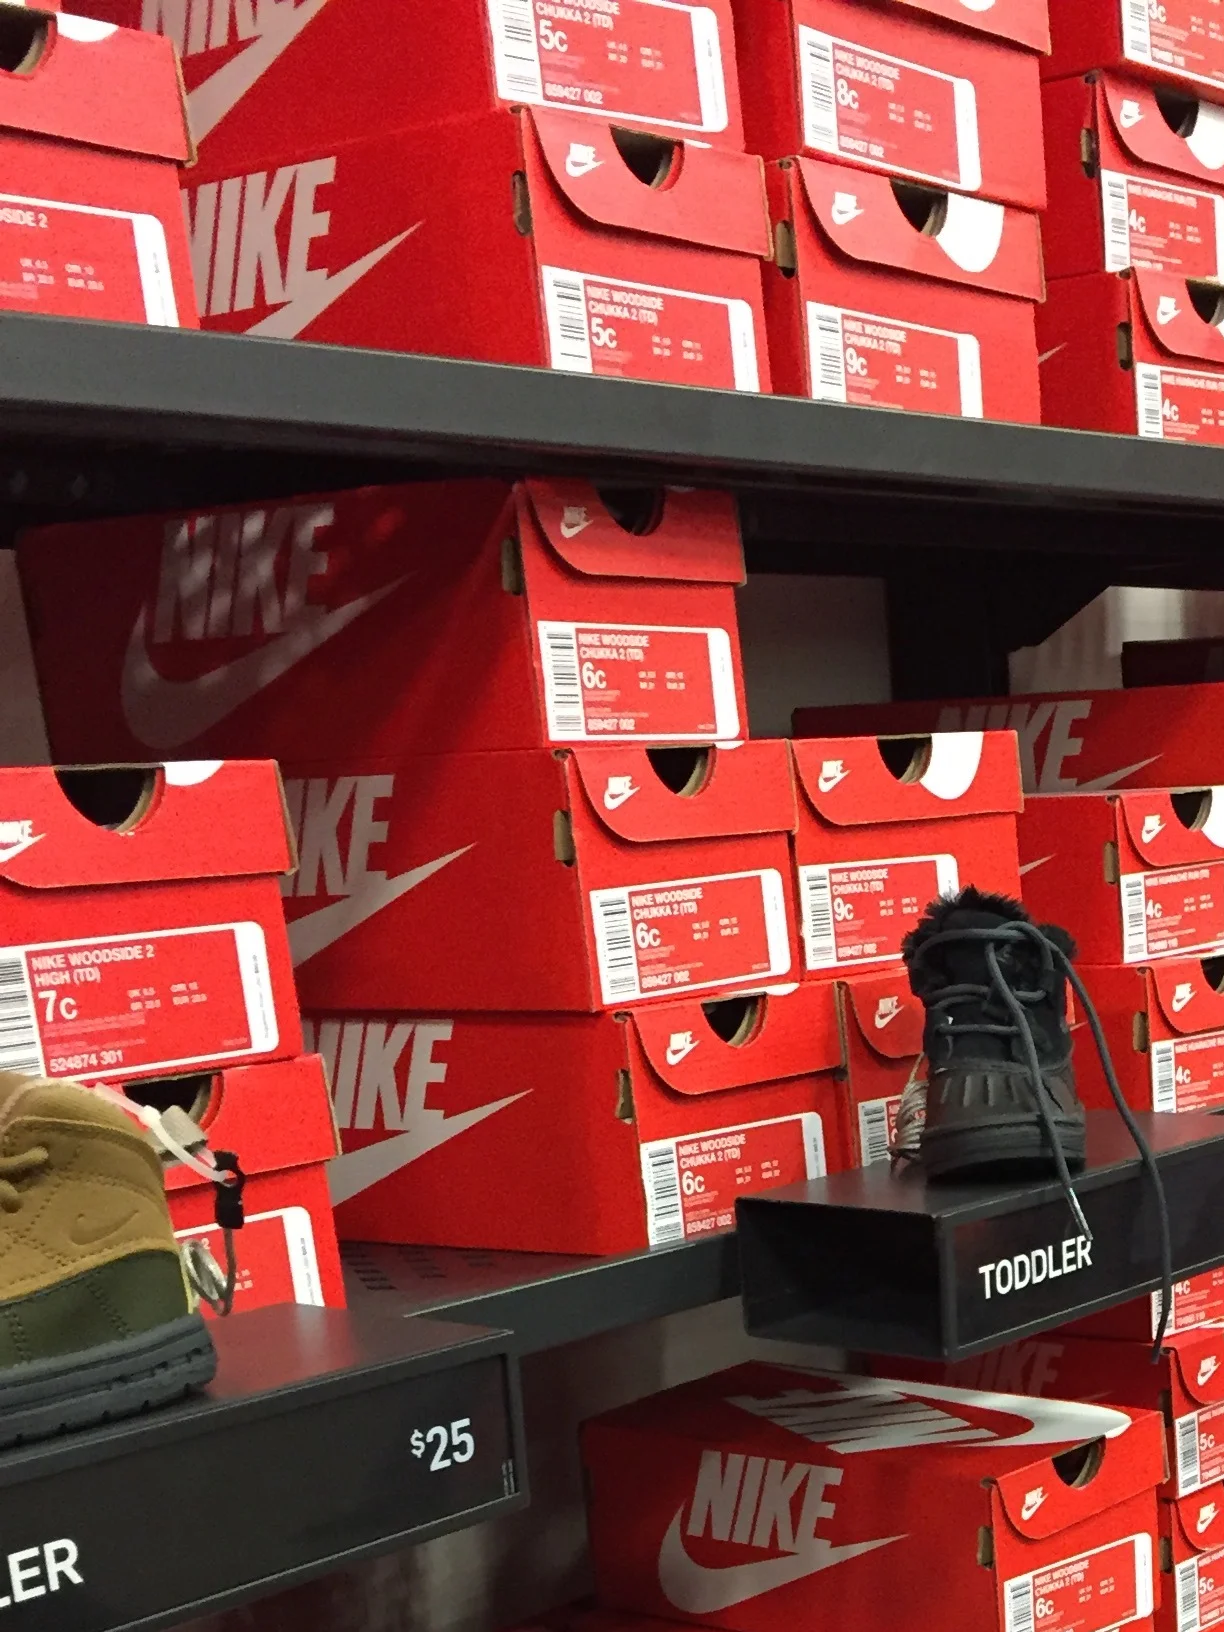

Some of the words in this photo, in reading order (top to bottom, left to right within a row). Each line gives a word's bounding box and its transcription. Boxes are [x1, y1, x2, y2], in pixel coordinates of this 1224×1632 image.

[540, 19, 568, 53] 5c
[837, 78, 859, 110] 8c
[591, 317, 618, 349] 5c
[846, 347, 868, 377] 9c
[153, 503, 337, 645] NIKE
[582, 661, 607, 690] 6c
[833, 897, 854, 922] 9c
[1146, 899, 1162, 919] 4c
[636, 922, 661, 949] 6c
[32, 952, 66, 971] NIKE
[69, 947, 143, 967] WOODSIDE
[145, 944, 155, 958] 2
[34, 970, 71, 988] HIGH
[73, 966, 101, 987] (TD)
[38, 990, 78, 1023] 7c
[50, 1052, 97, 1074] 524874
[100, 1050, 123, 1067] 301
[1175, 1066, 1191, 1084] 4c
[681, 1170, 705, 1195] 6c
[978, 1235, 1093, 1299] TODDLER
[410, 1417, 475, 1472] $25
[1199, 1432, 1215, 1451] 5c
[687, 1449, 843, 1556] NIKE
[1199, 1576, 1214, 1594] 5c
[1036, 1597, 1054, 1618] 6c
